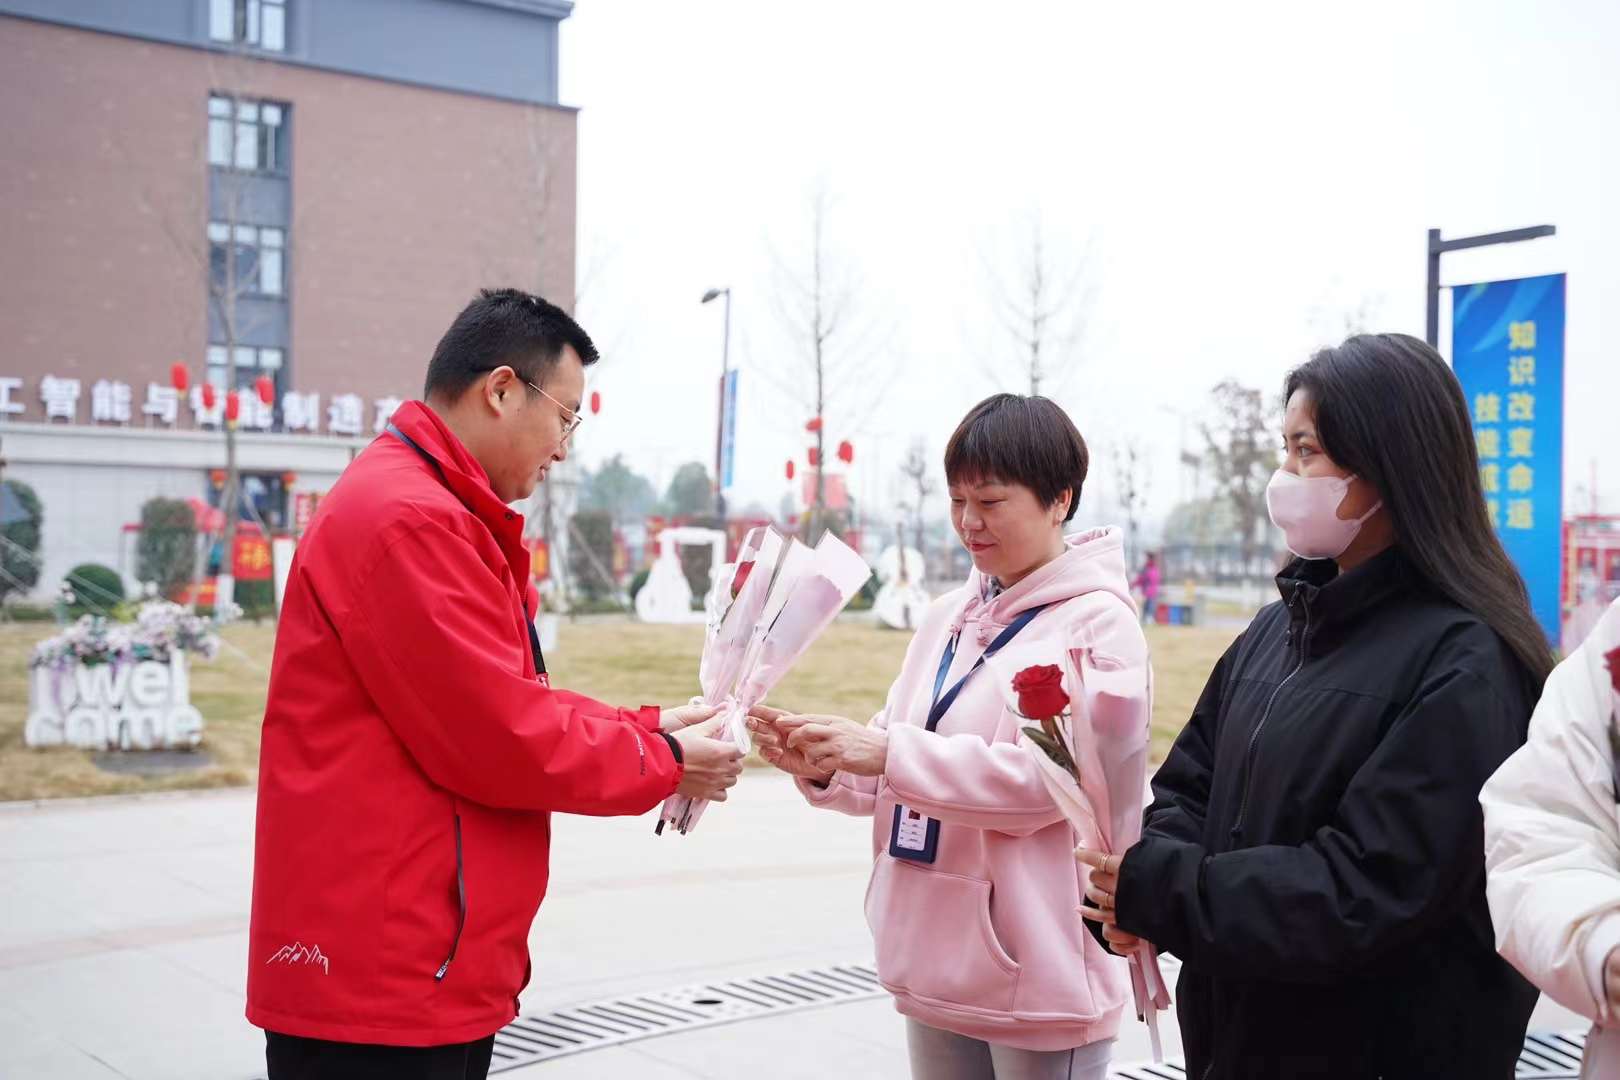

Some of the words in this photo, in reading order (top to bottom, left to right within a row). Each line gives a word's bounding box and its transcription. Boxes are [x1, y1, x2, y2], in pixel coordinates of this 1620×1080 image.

[1507, 320, 1535, 529] 知识改变命运
